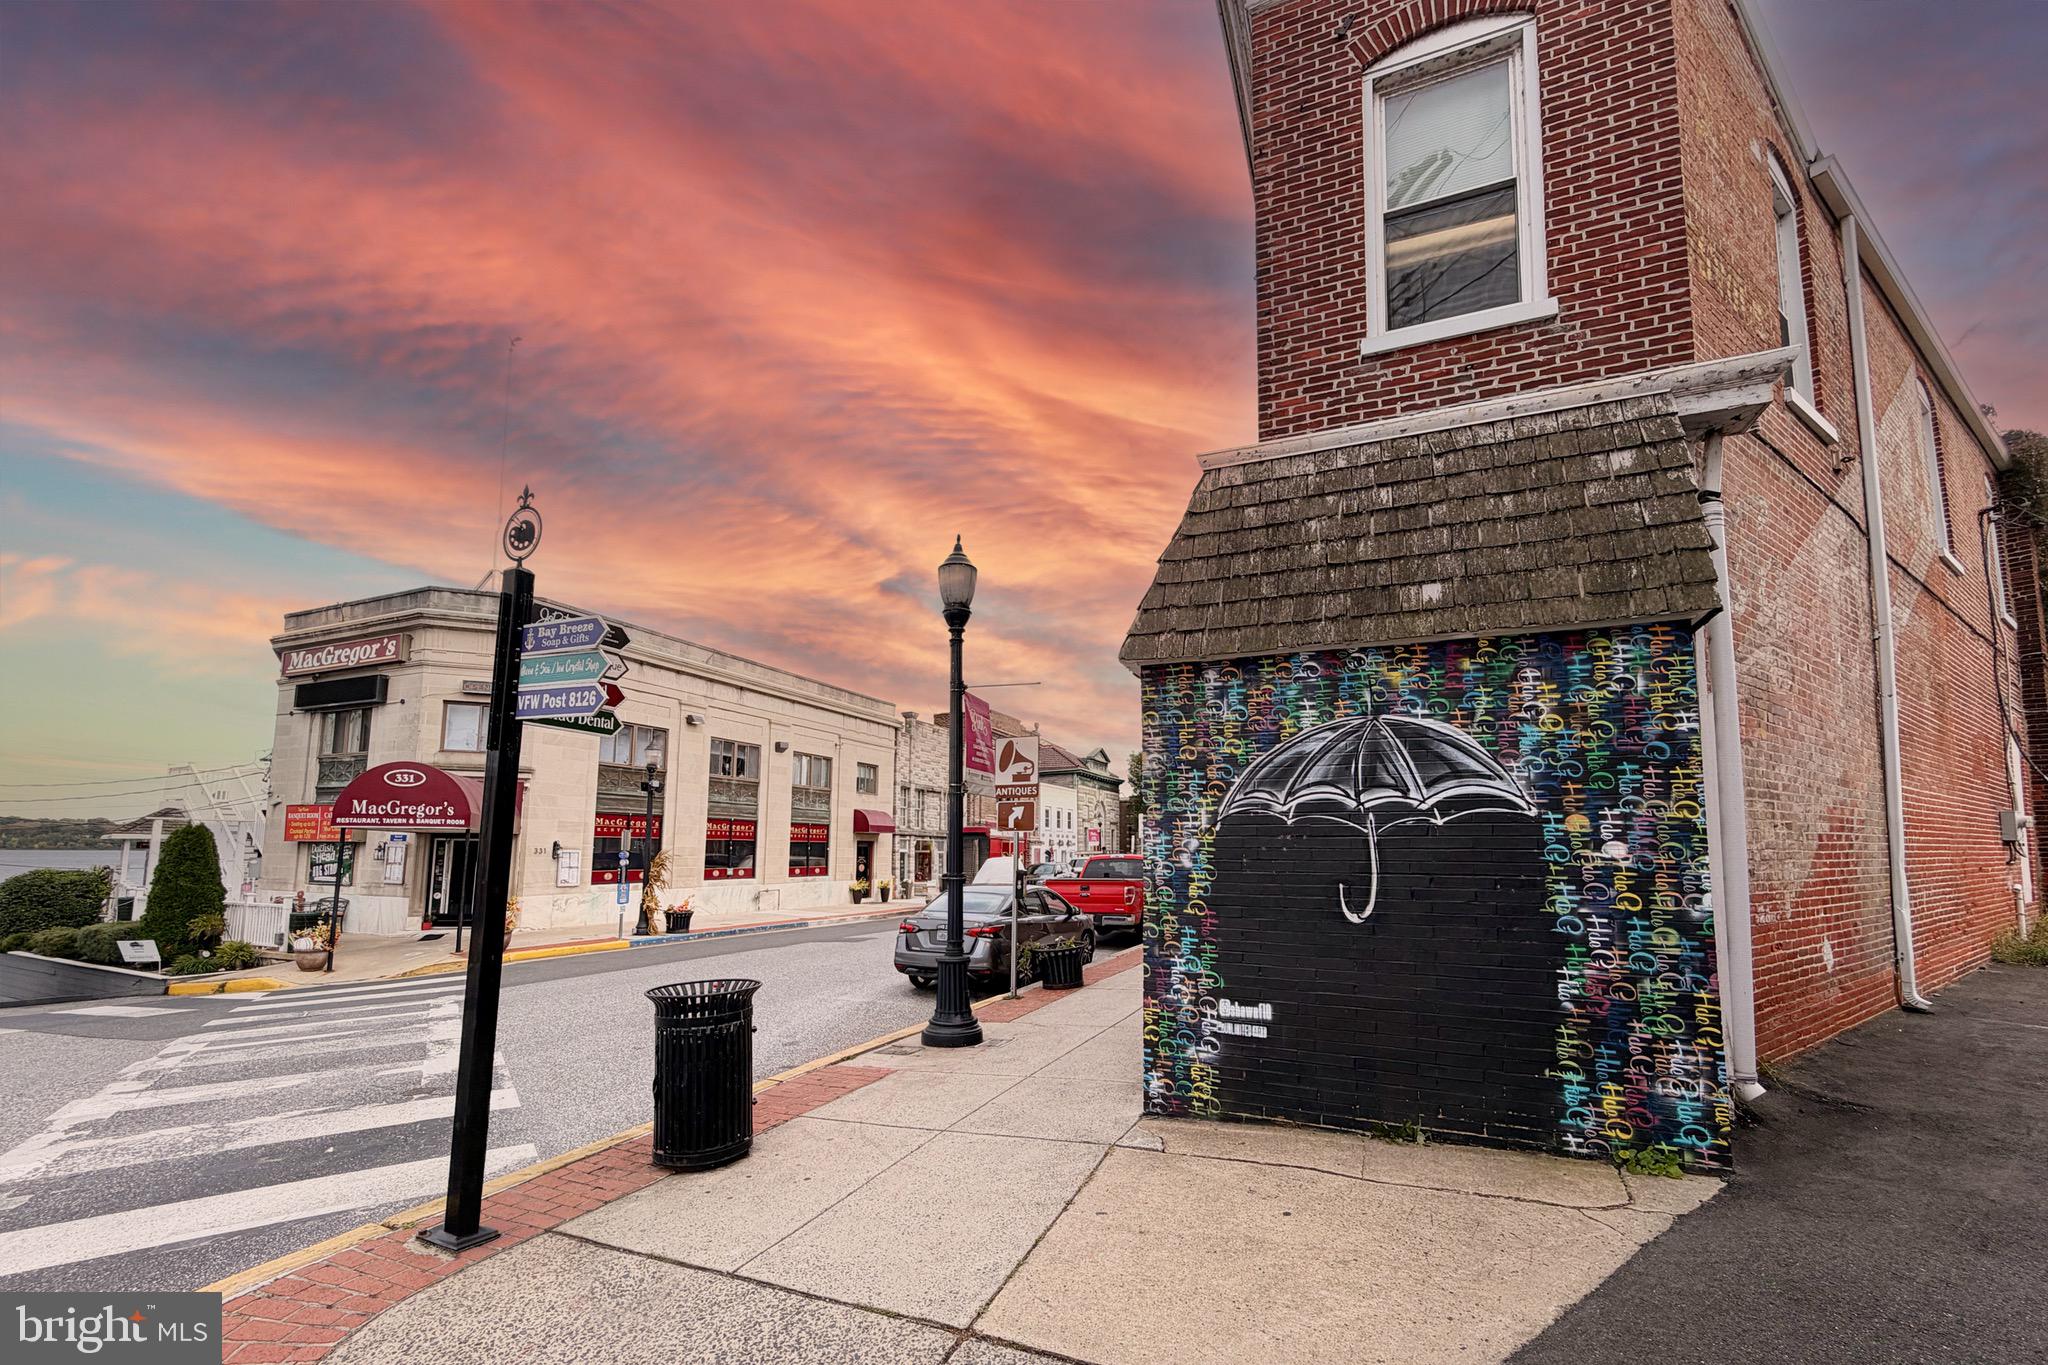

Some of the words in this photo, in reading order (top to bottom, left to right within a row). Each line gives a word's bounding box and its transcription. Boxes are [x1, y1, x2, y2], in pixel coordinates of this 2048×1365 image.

[538, 626, 558, 638] Bay
[559, 622, 594, 635] Breeze
[541, 637, 561, 648] Soap
[562, 636, 568, 644] &
[570, 633, 590, 643] Gifts
[287, 637, 397, 670] MacGregor's
[518, 694, 540, 710] VFW
[542, 693, 566, 709] Post
[568, 690, 597, 707] 8126
[578, 715, 615, 730] Dental
[394, 774, 415, 783] 331
[996, 786, 1038, 796] ANTIQUES
[351, 799, 455, 818] MacGregor's
[595, 817, 660, 829] MacGrego's
[533, 847, 547, 855] 331
